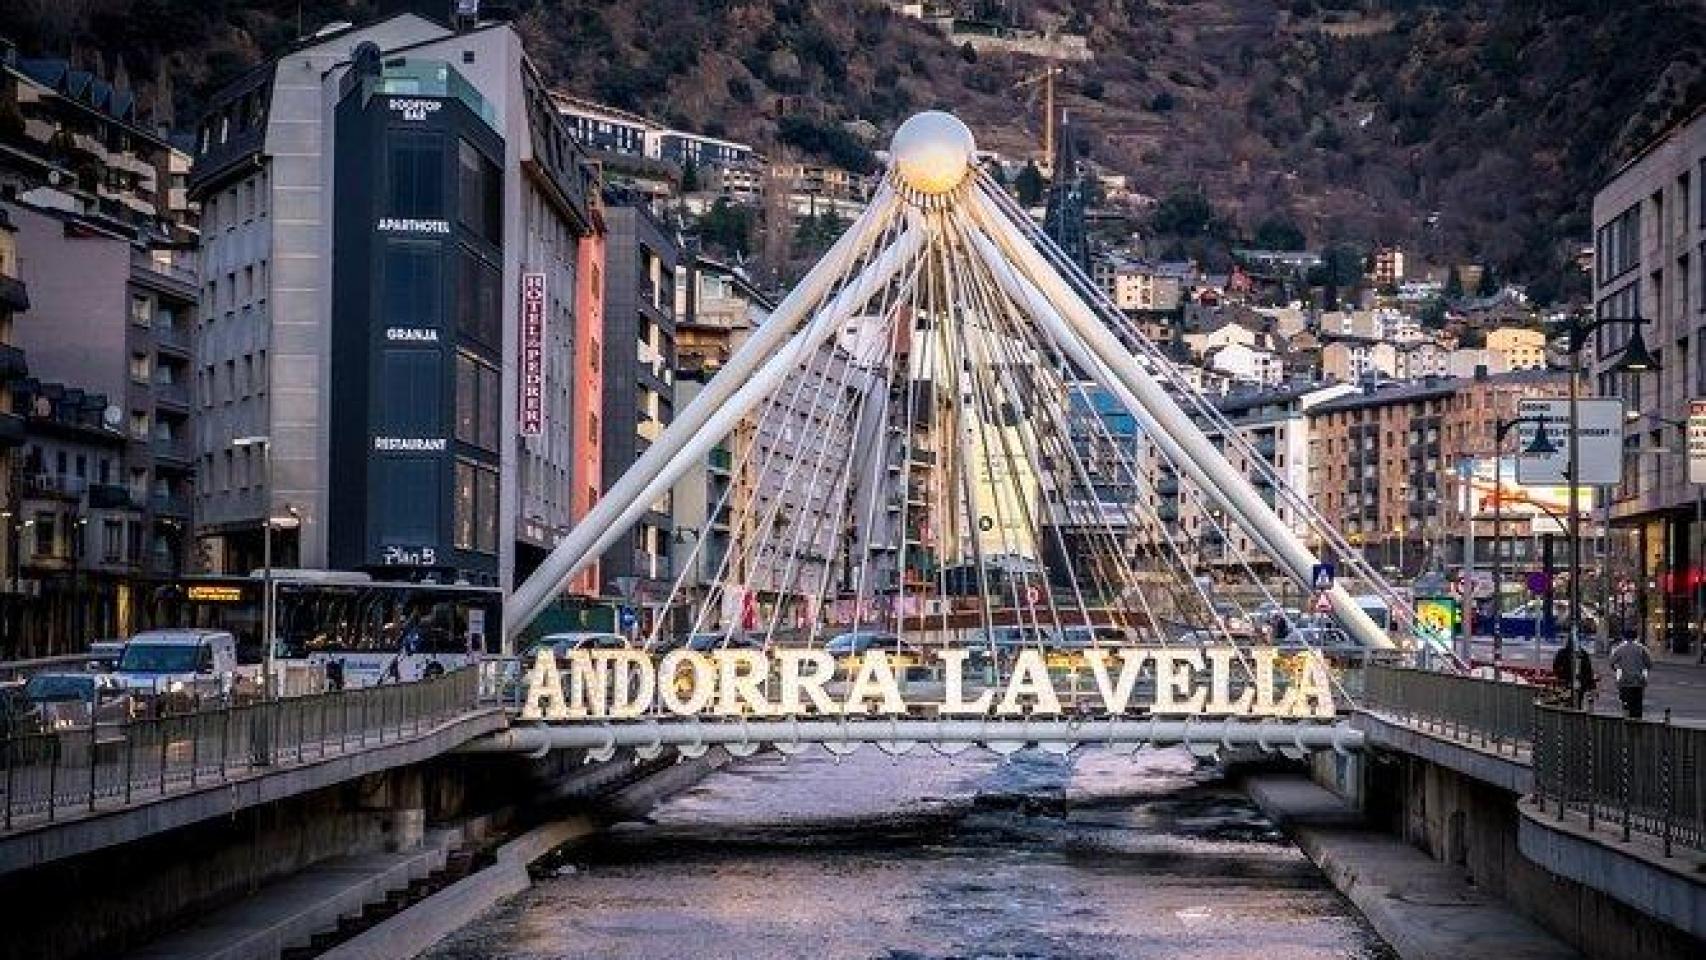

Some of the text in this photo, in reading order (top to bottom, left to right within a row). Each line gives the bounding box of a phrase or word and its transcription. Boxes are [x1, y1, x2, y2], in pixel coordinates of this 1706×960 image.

[378, 218, 450, 233] APARTHOTEL
[386, 327, 439, 342] GRANJA
[374, 437, 447, 451] RESTAURANT
[384, 546, 435, 565] Plan B
[522, 647, 1337, 719] ANDORRA LA VELLA
